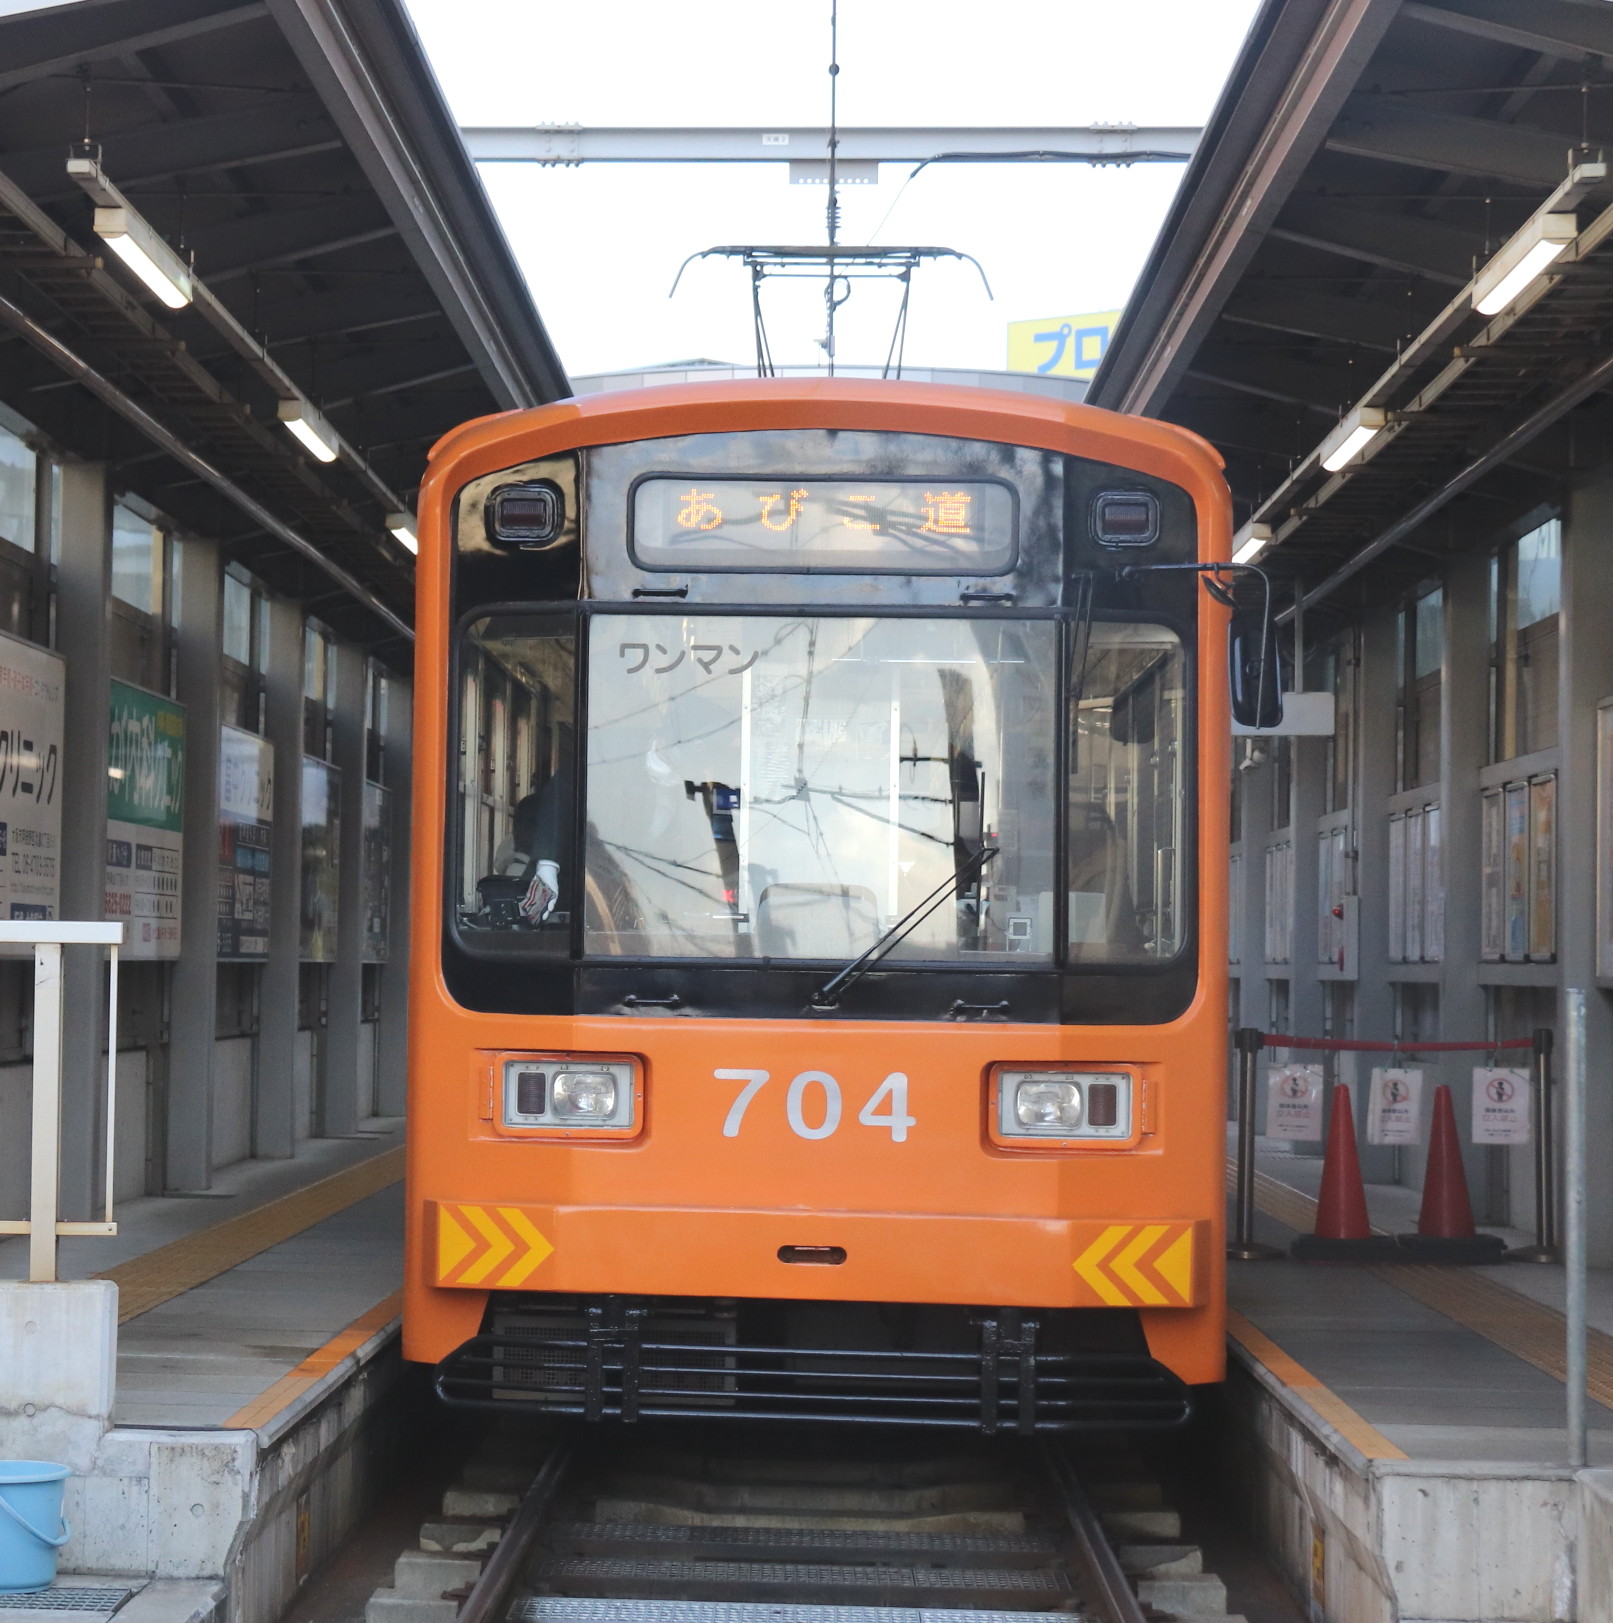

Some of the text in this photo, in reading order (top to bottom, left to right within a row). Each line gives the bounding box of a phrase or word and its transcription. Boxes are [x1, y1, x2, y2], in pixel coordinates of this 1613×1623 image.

[1033, 323, 1109, 374] プロ
[677, 488, 971, 533] あびこ道
[619, 643, 760, 674] ワンマン
[713, 1068, 916, 1143] 704
